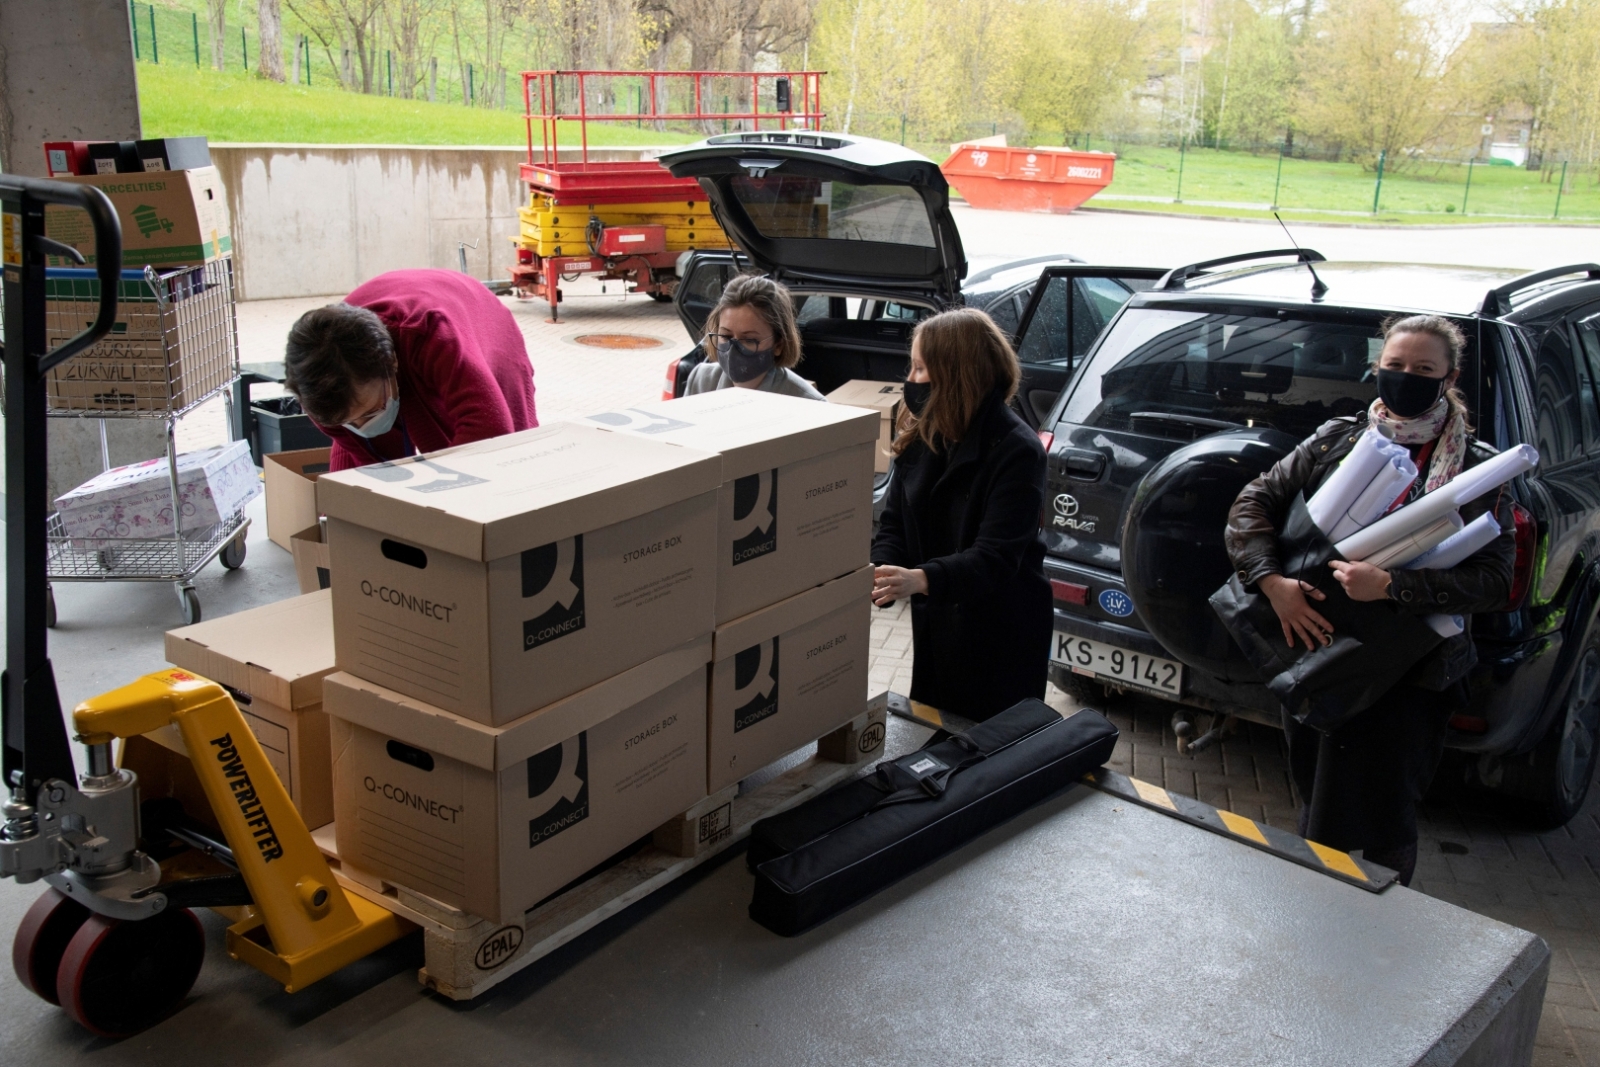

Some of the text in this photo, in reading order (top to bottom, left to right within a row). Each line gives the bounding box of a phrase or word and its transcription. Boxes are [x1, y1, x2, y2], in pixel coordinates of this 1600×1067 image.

[97, 182, 167, 194] ĀRCELTIES!
[805, 478, 848, 500] STORAGE BOX
[1052, 515, 1096, 534] RAV4
[623, 535, 683, 564] STORAGE BOX
[1110, 597, 1123, 610] LV
[806, 633, 847, 660] STORAGE BOX
[1053, 662, 1070, 670] TOYOTA
[1057, 634, 1178, 691] KS-9142
[624, 713, 678, 750] STORAGE BOX
[862, 727, 881, 750] EPAL
[209, 732, 284, 864] POWERLIFTER
[482, 933, 517, 965] EPAL
